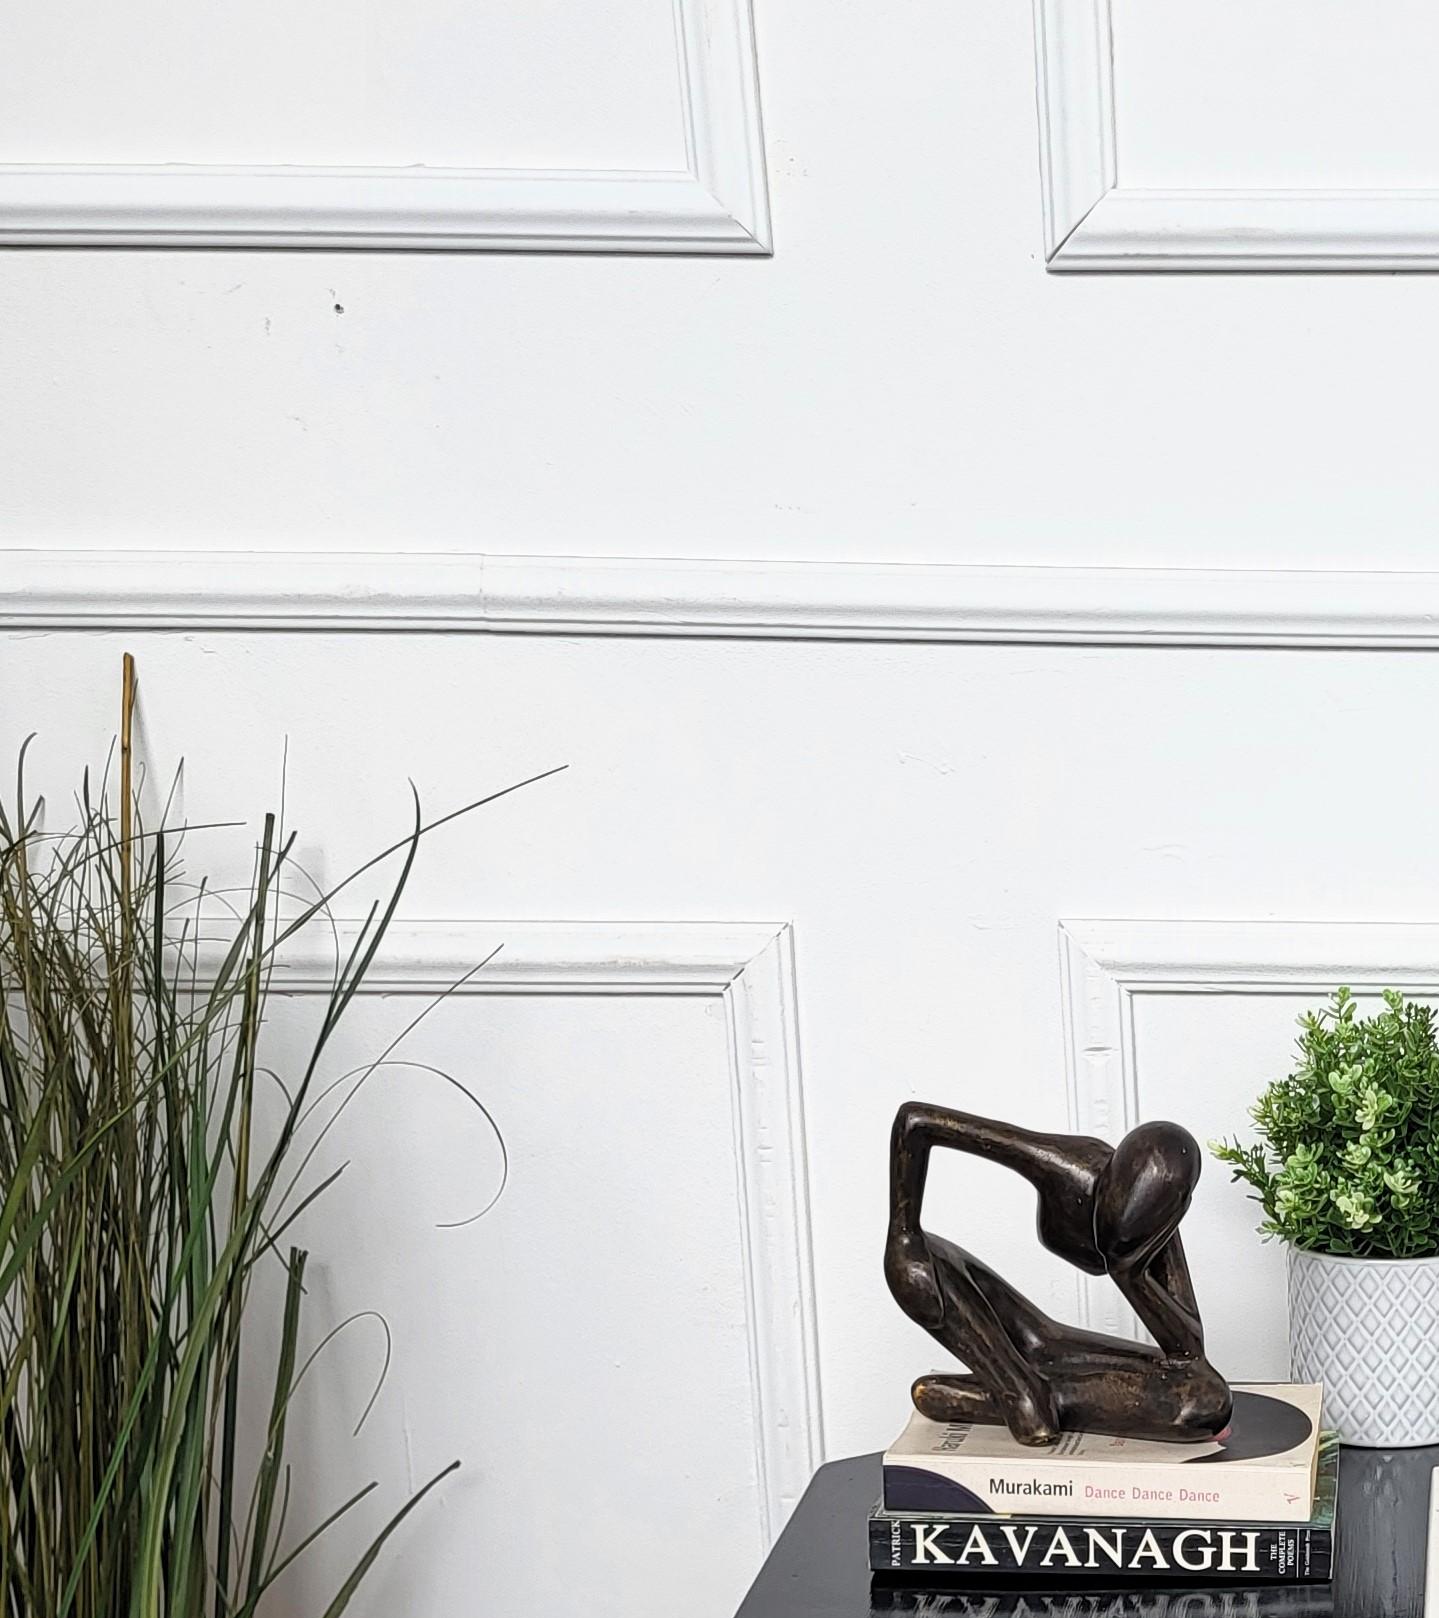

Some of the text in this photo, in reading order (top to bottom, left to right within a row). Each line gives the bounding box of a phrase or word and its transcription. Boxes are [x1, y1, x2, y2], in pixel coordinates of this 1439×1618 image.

[989, 1478, 1220, 1502] Murakami Dance Dance Dance
[891, 1520, 901, 1566] PATRICK
[910, 1523, 1261, 1571] KAVANAGH
[1287, 1539, 1295, 1566] POEMS
